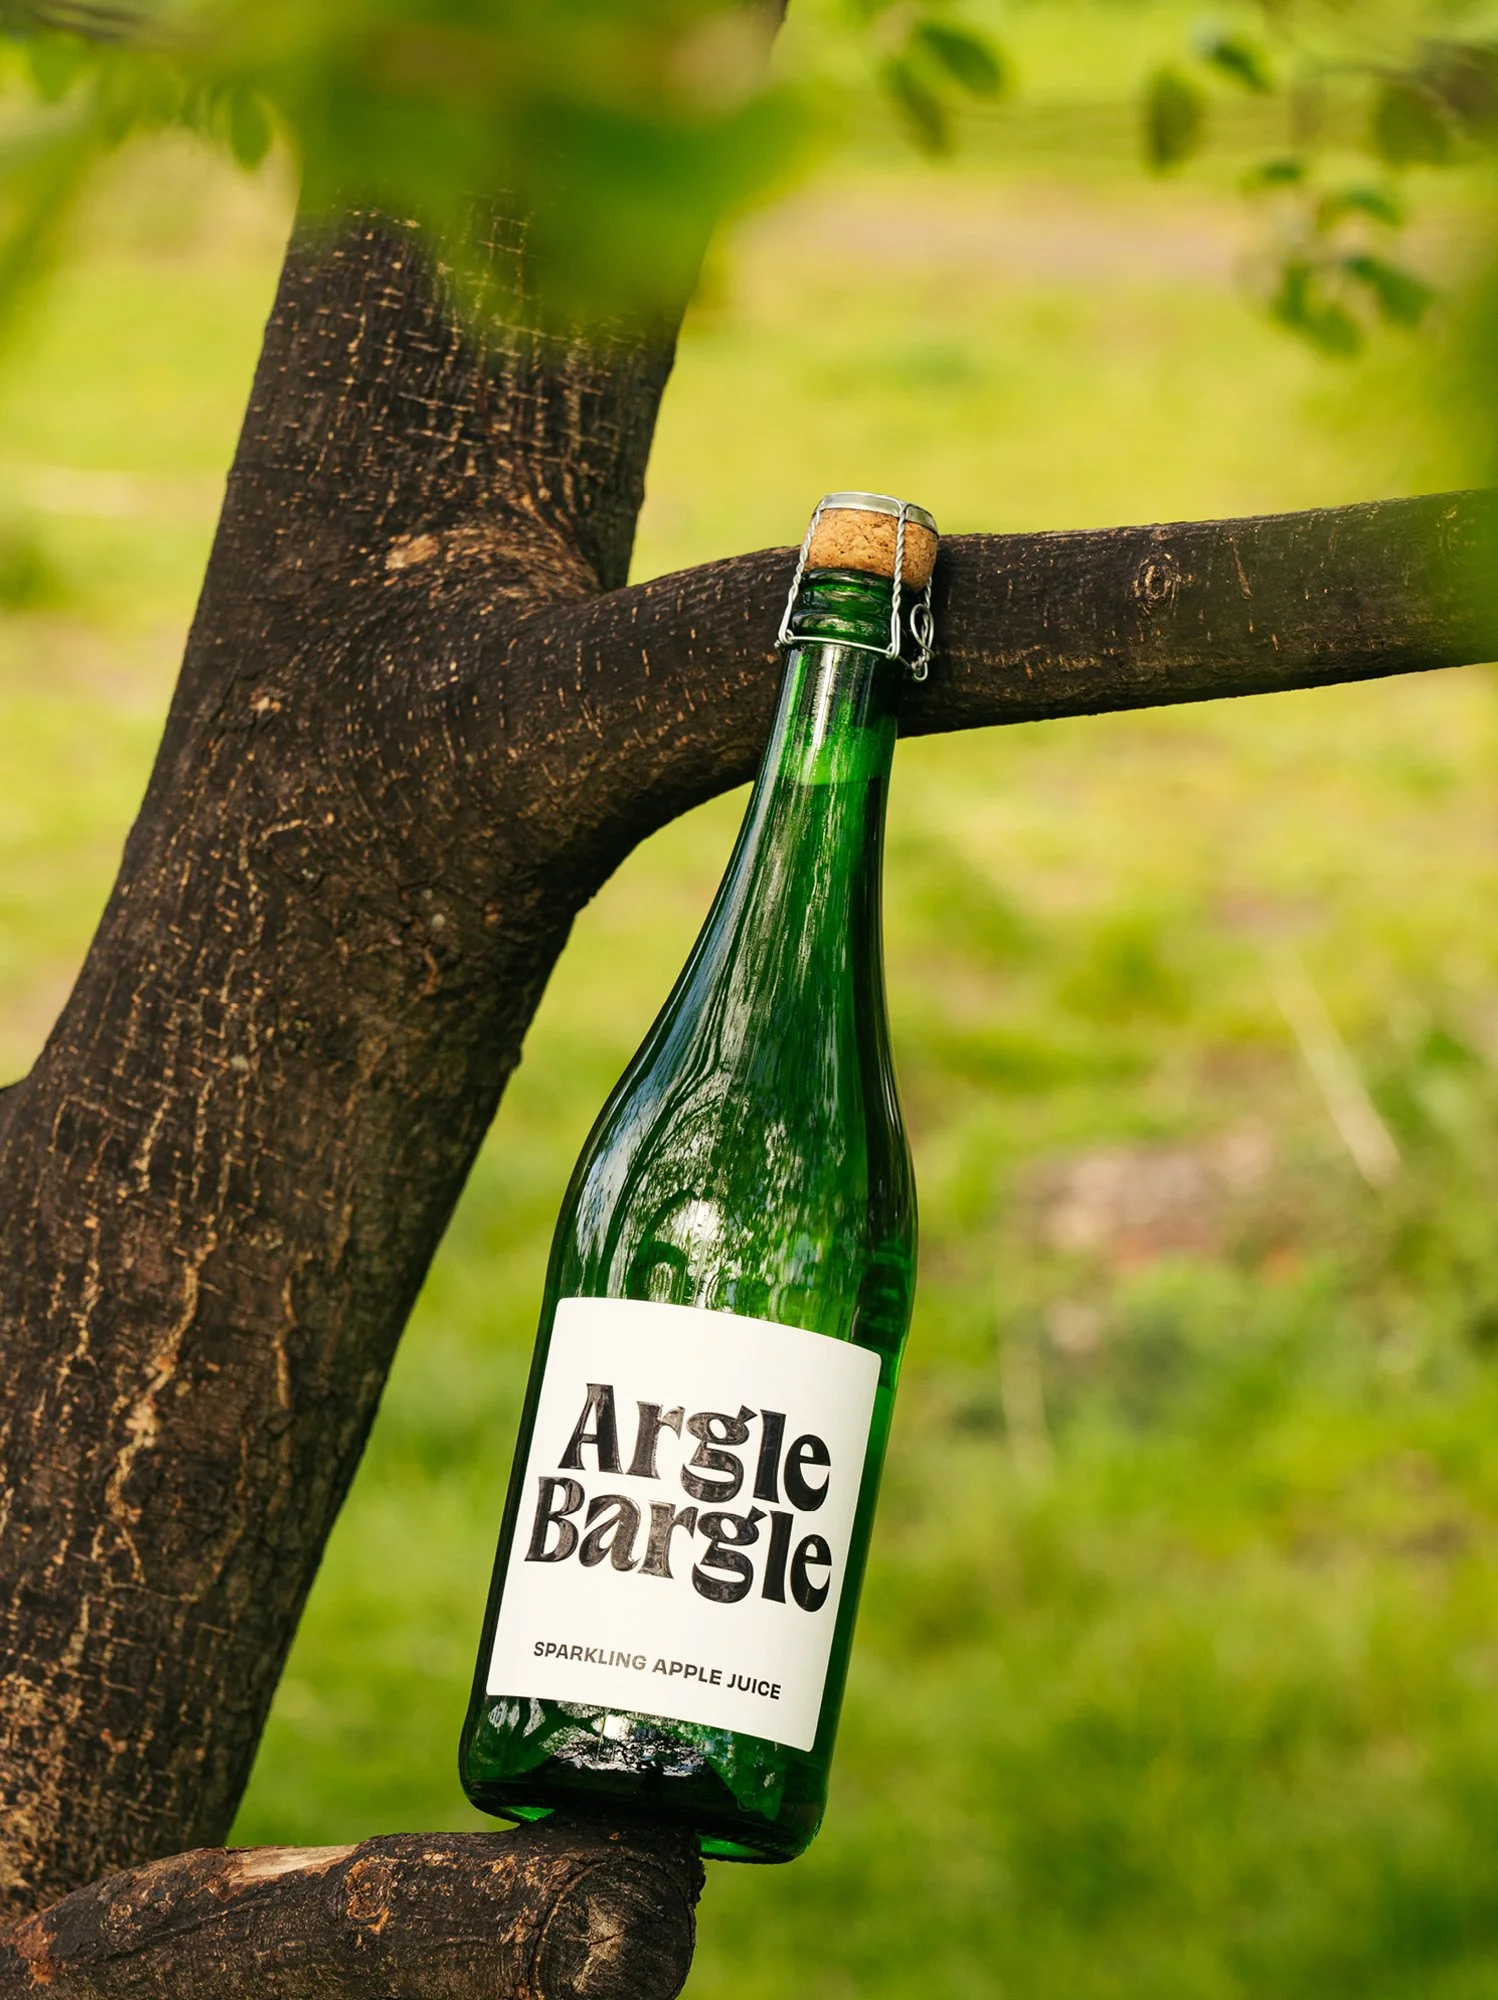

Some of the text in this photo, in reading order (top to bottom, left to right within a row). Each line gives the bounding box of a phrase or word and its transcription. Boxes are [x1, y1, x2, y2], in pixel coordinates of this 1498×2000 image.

[558, 1383, 831, 1512] Argle
[524, 1476, 832, 1612] Bargle
[533, 1641, 781, 1700] SPARKLING APPLE JUICE
